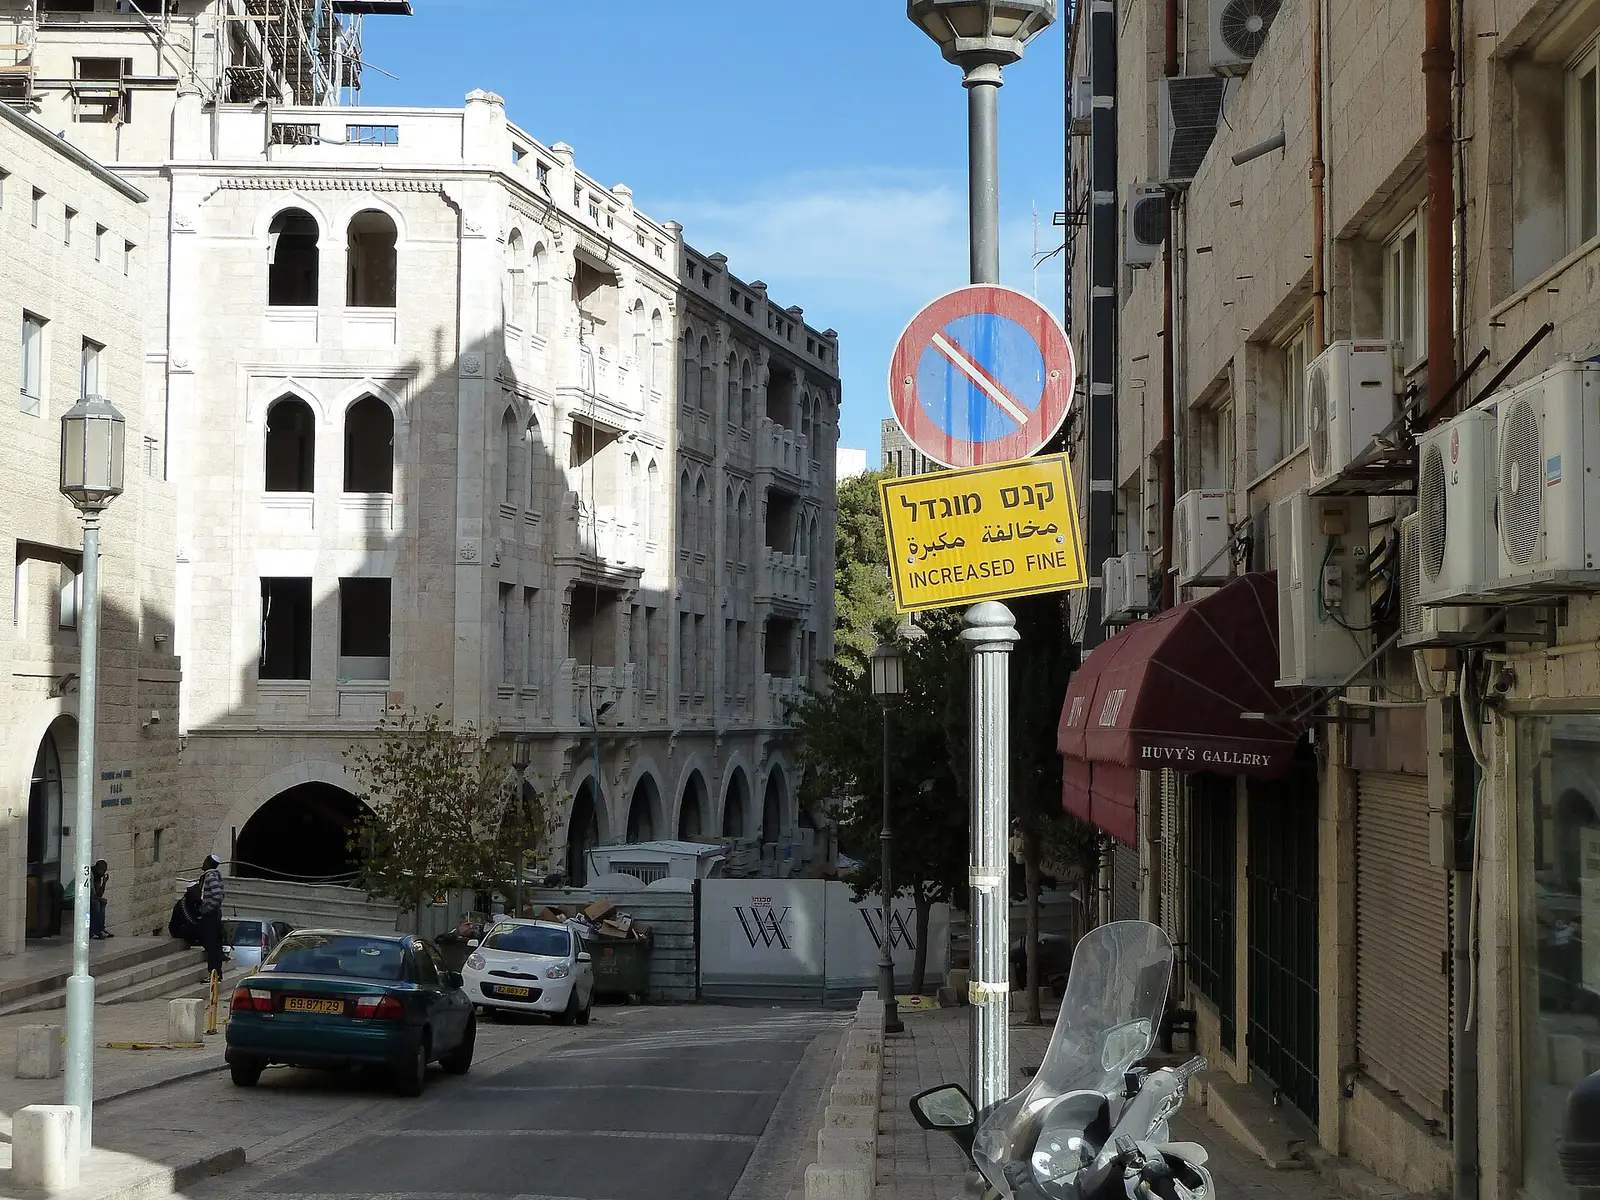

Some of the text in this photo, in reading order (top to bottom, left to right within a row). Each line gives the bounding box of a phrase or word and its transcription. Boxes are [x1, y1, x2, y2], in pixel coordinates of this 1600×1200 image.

[900, 481, 1055, 522] קנס מוגדל
[907, 519, 1058, 560] مخالفة مكبرة
[908, 550, 1067, 589] INCREASED FINE
[1141, 746, 1272, 766] HUVY'S GALLERY
